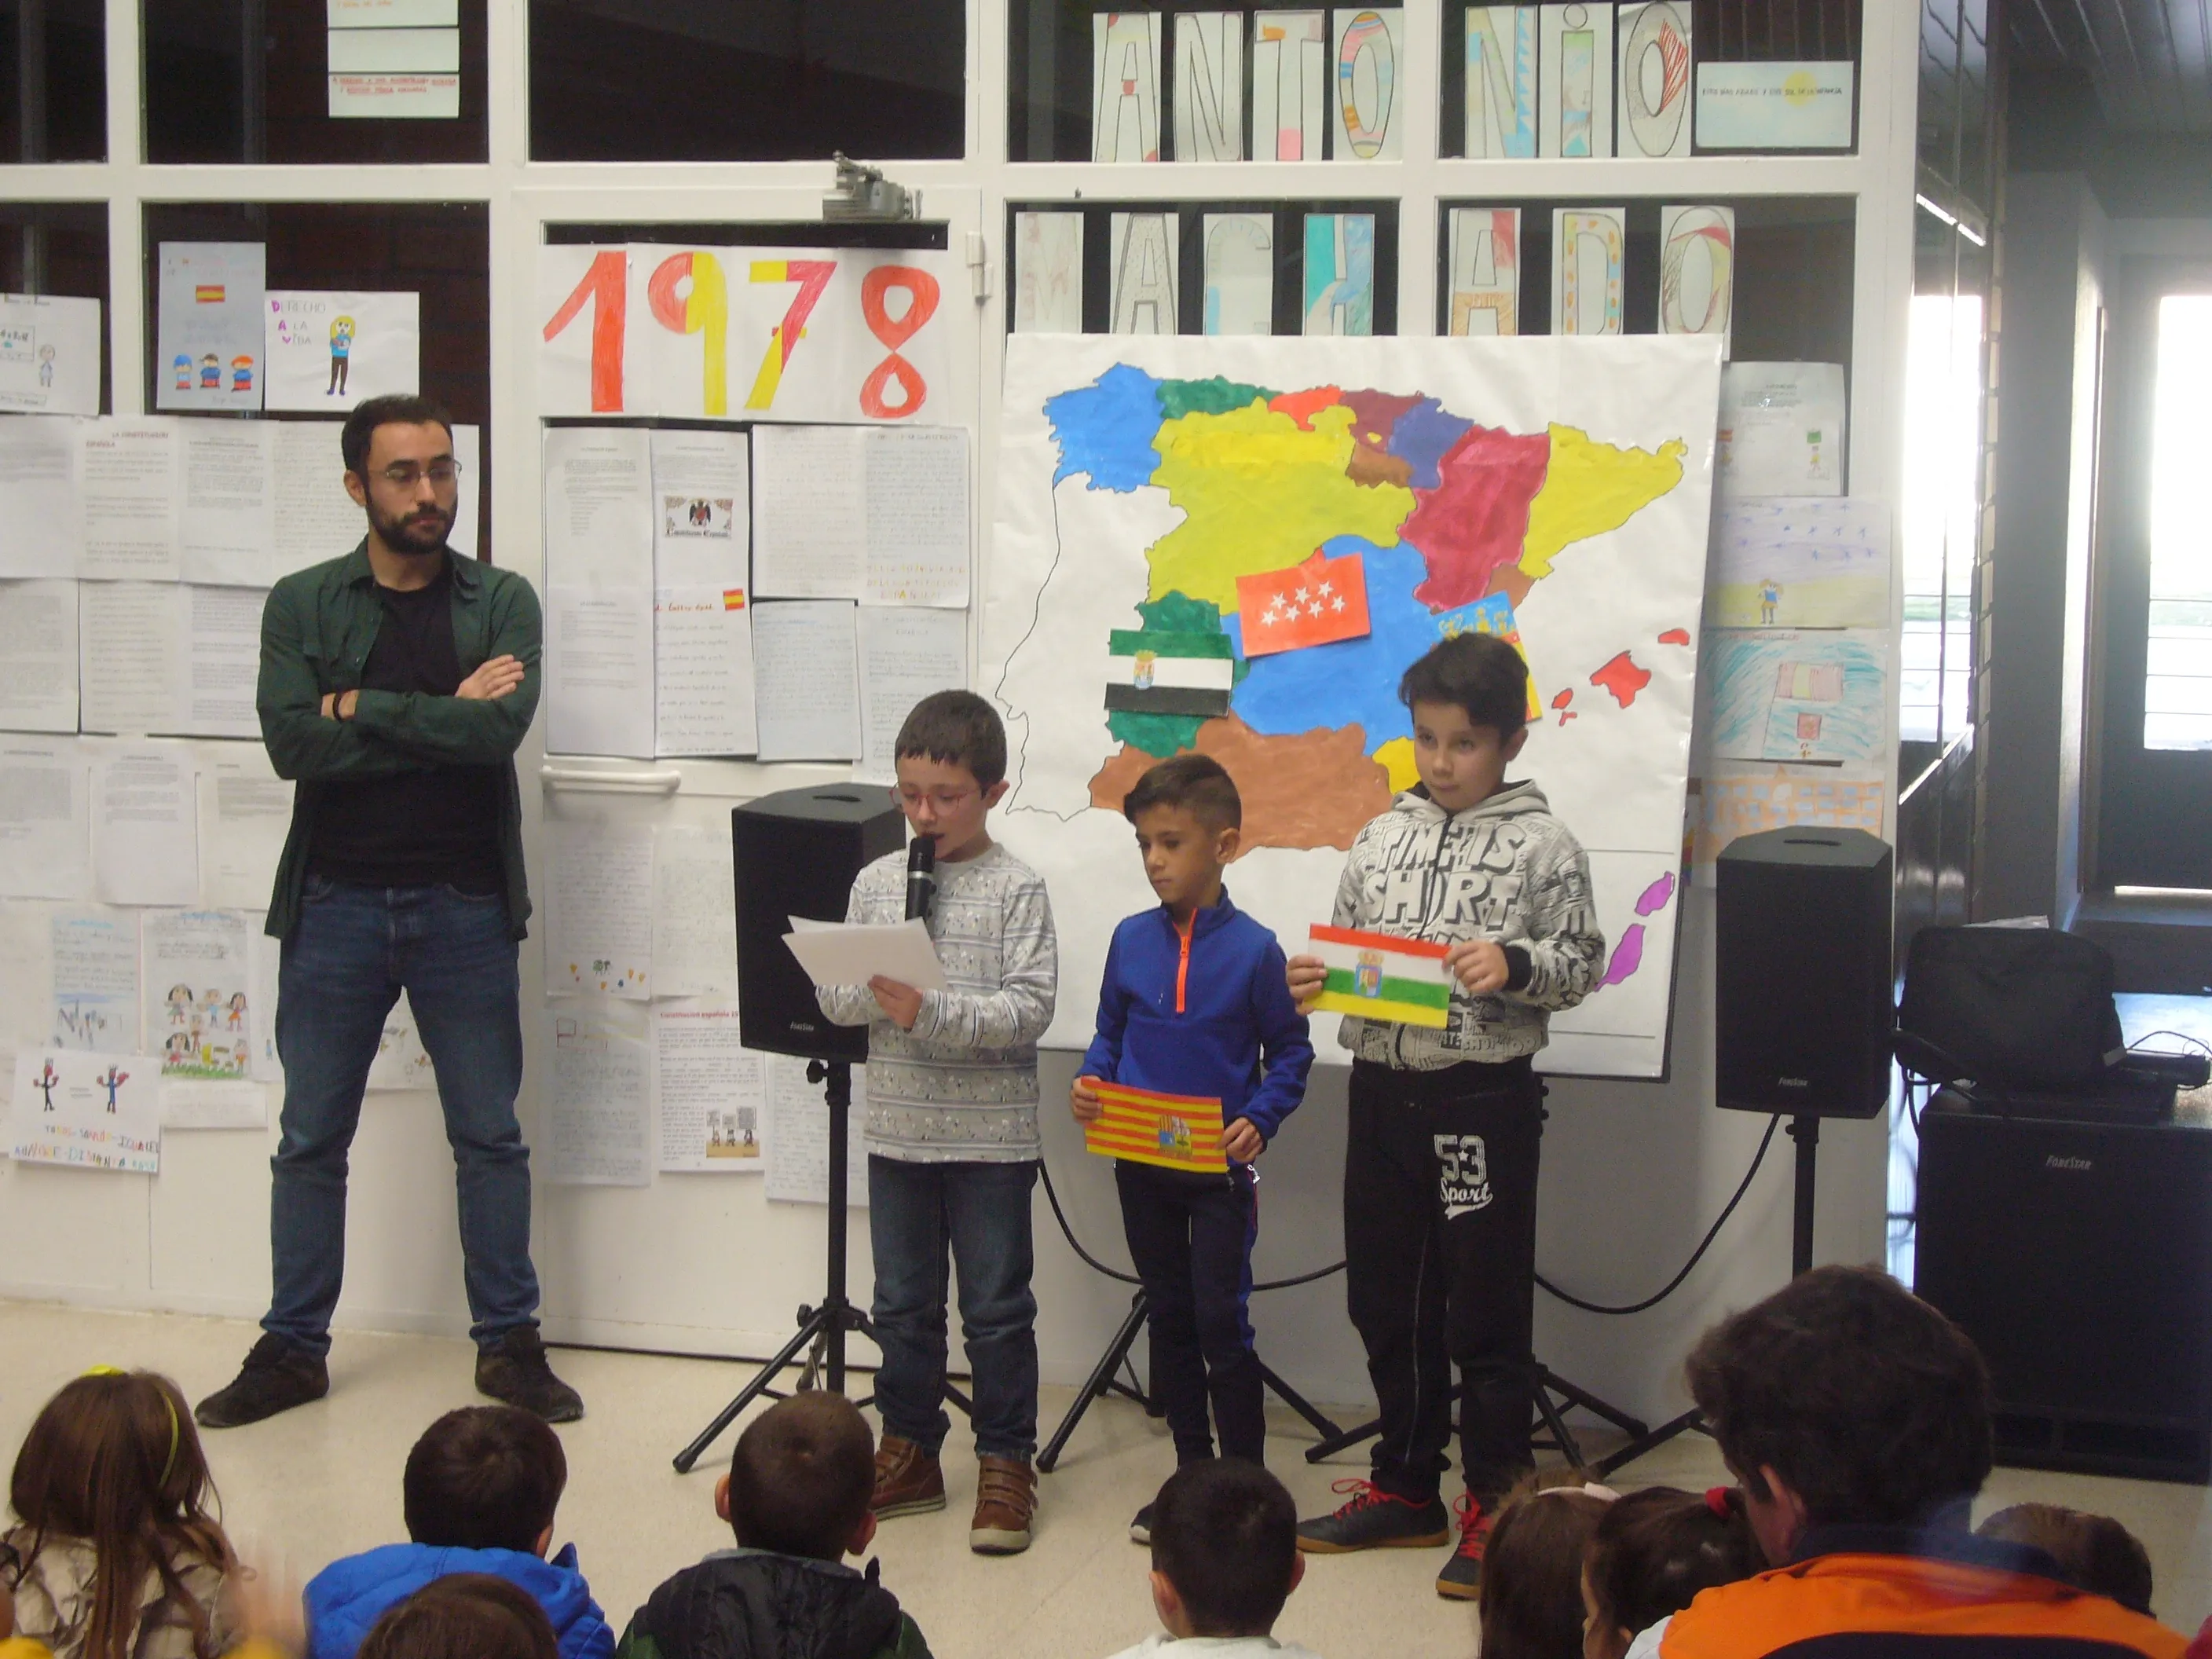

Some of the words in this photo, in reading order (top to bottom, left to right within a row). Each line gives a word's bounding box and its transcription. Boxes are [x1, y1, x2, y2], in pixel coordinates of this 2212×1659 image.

[271, 300, 326, 313] DERECHO
[278, 320, 287, 331] A
[294, 320, 308, 331] LA
[543, 251, 940, 419] 1978
[1467, 822, 1527, 874] IS
[1434, 1134, 1488, 1185] 53
[1440, 1177, 1492, 1210] Sport
